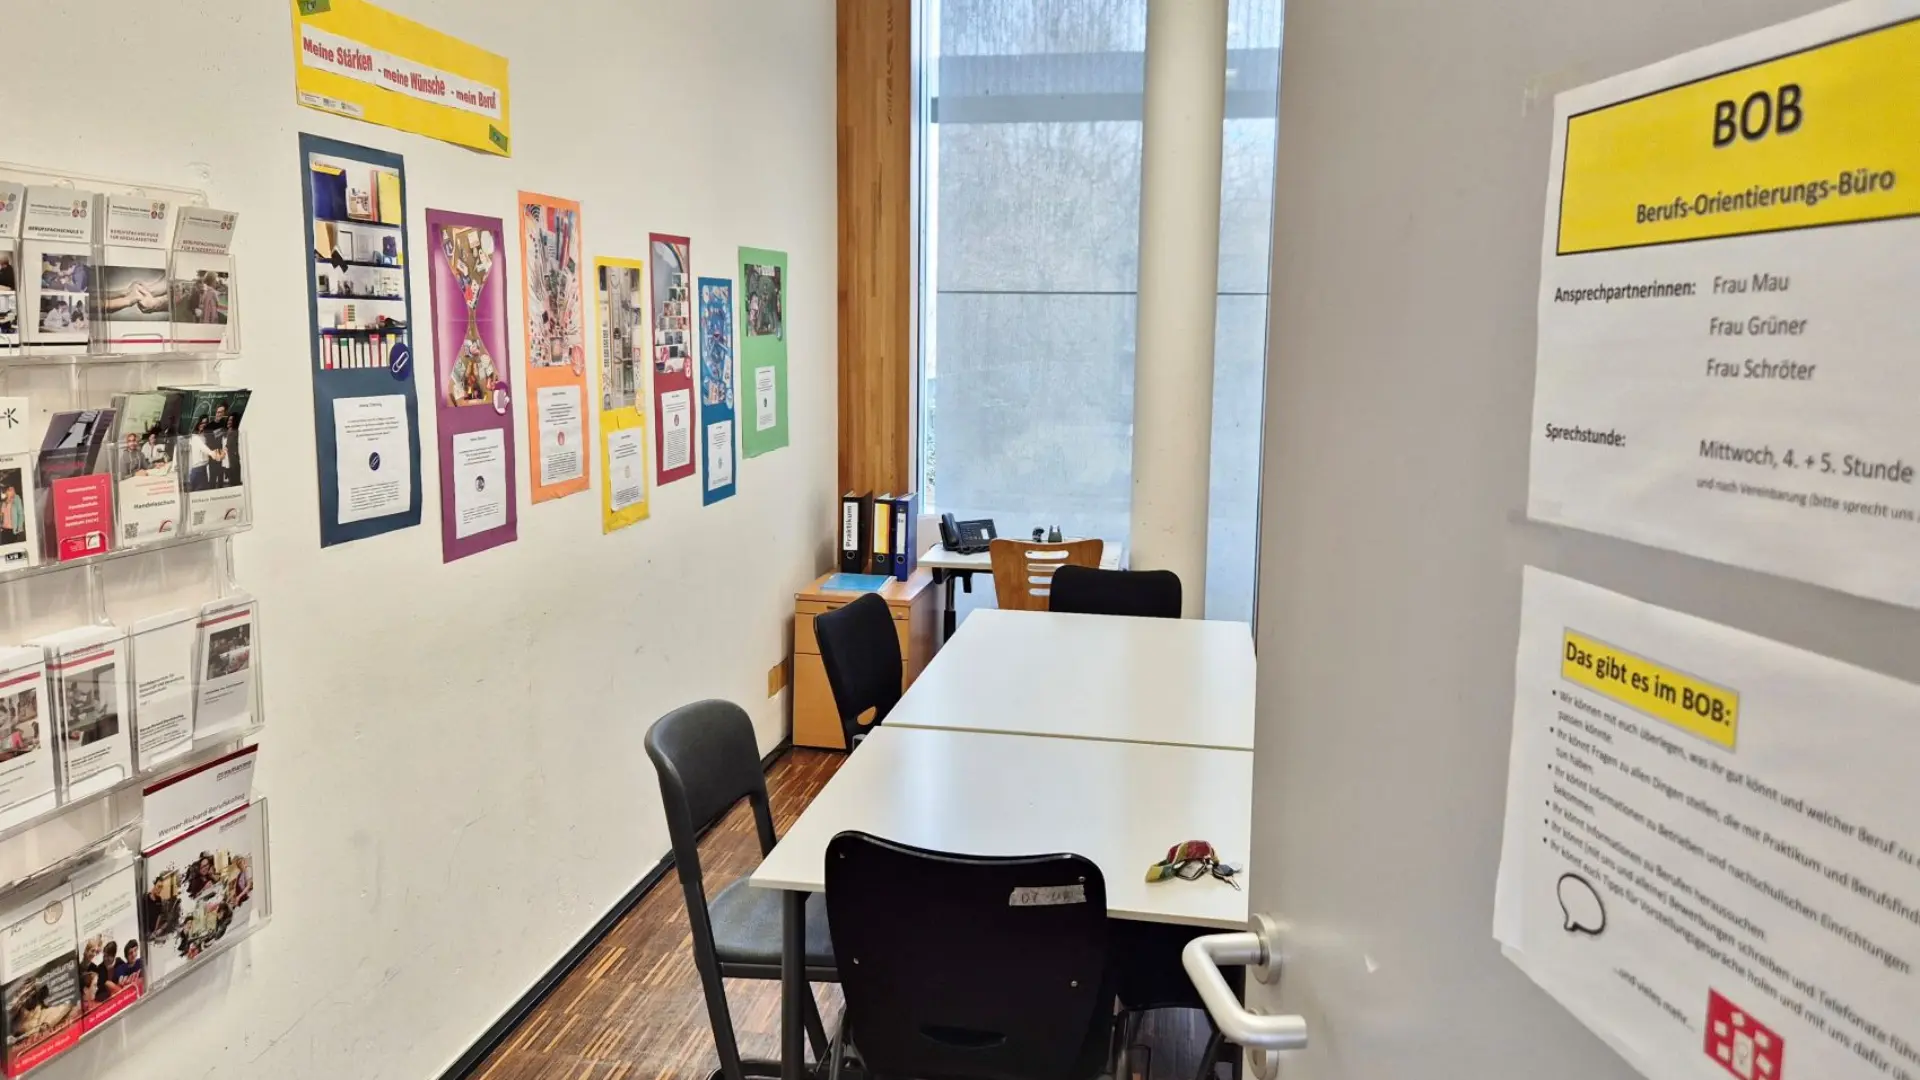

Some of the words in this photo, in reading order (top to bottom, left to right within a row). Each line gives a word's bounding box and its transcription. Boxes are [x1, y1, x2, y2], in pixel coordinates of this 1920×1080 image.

[303, 37, 334, 63] Meine
[337, 46, 373, 72] Stärken
[383, 67, 409, 88] meine
[410, 72, 446, 96] Wünsche
[456, 90, 477, 106] mein
[478, 91, 497, 110] Beruf
[1712, 82, 1804, 148] BOB
[1636, 168, 1895, 224] Berufs-Orientierungs-Büro
[1554, 280, 1697, 303] Ansprechpartnerinnen:
[1713, 276, 1747, 295] Frau
[1752, 273, 1789, 293] Mau
[1710, 317, 1743, 336] Frau
[1748, 315, 1807, 336] Grüner
[1706, 358, 1739, 378] Frau
[1743, 358, 1815, 380] Schröter
[1545, 423, 1626, 447] Sprechstunde:
[1699, 440, 1778, 469] Mittwoch,
[1782, 448, 1799, 469] 4.
[1804, 454, 1815, 467] +
[1820, 452, 1836, 474] 5.
[1842, 455, 1914, 484] Stunde
[845, 505, 853, 547] Praktikum
[1697, 478, 1714, 490] und
[1741, 485, 1807, 507] Vereinbarung
[1809, 493, 1839, 510] (bitte
[1842, 500, 1888, 518] sprecht
[1891, 508, 1913, 521] uns
[1565, 640, 1593, 669] Das
[1596, 655, 1626, 685] gibt
[1631, 672, 1649, 693] es
[1653, 674, 1676, 704] im
[1682, 687, 1732, 727] BOB:
[1689, 752, 1708, 769] was
[1710, 761, 1724, 775] ihr
[1726, 769, 1743, 783] gut
[1746, 776, 1778, 800] könnt
[1781, 793, 1804, 813] und
[1806, 806, 1855, 837] welcher
[1858, 826, 1896, 855] Beruf
[1898, 850, 1912, 865] zu
[1723, 813, 1741, 830] die
[1742, 825, 1761, 841] mit
[1763, 832, 1820, 873] Praktikum
[1823, 866, 1848, 887] und
[1851, 877, 1920, 928] Berufsfind
[1706, 852, 1727, 870] und
[1728, 864, 1818, 922] nachschulischen
[1820, 913, 1910, 974] Einrichtungen
[1737, 941, 1790, 980] schreiben
[1792, 975, 1815, 999] und
[1819, 989, 1887, 1043] Telefonate
[1889, 1035, 1920, 1068] führ
[1747, 969, 1778, 999] holen
[1780, 992, 1802, 1015] und
[1805, 1008, 1826, 1032] mit
[1828, 1023, 1850, 1048] uns
[1853, 1040, 1890, 1072] dafür
